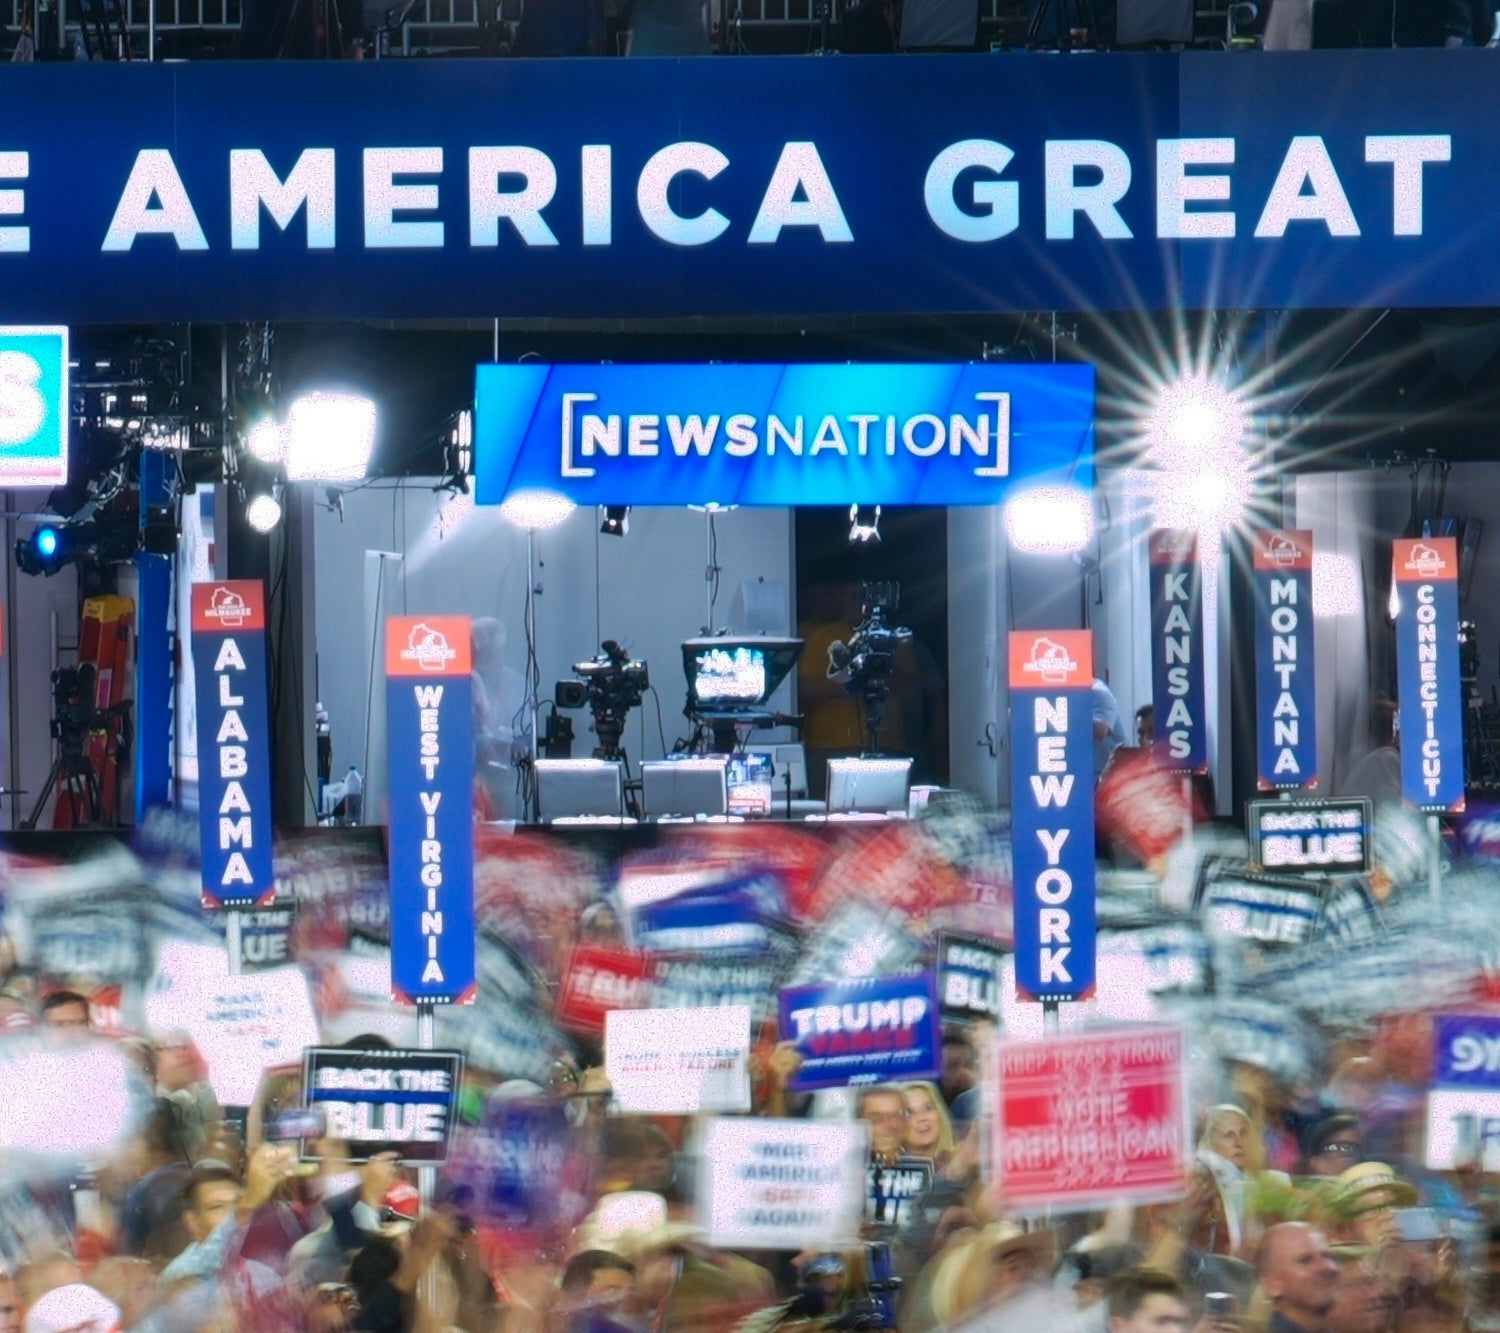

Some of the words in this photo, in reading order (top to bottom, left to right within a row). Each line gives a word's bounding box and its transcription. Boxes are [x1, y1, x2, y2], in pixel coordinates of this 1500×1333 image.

[101, 140, 854, 252] AMERICA
[923, 132, 1453, 244] GREAT
[1164, 572, 1193, 759] KANSAS
[1269, 579, 1301, 776] MONTANA
[1417, 585, 1441, 798] CONNECTICUT
[213, 638, 254, 885] ALABAMA
[414, 685, 445, 780] WEST
[1030, 697, 1075, 807] NEW
[1261, 833, 1364, 867] BLUE
[1319, 810, 1362, 828] THE
[418, 791, 444, 983] VIRGINIA
[1036, 829, 1074, 983] YORK
[792, 997, 926, 1036] TRUMP
[1113, 1037, 1182, 1068] STRONG
[317, 1067, 392, 1093] BACK
[393, 1069, 451, 1093] THE
[322, 1101, 449, 1142] BLUE
[1005, 1129, 1179, 1173] REPUBLICAN
